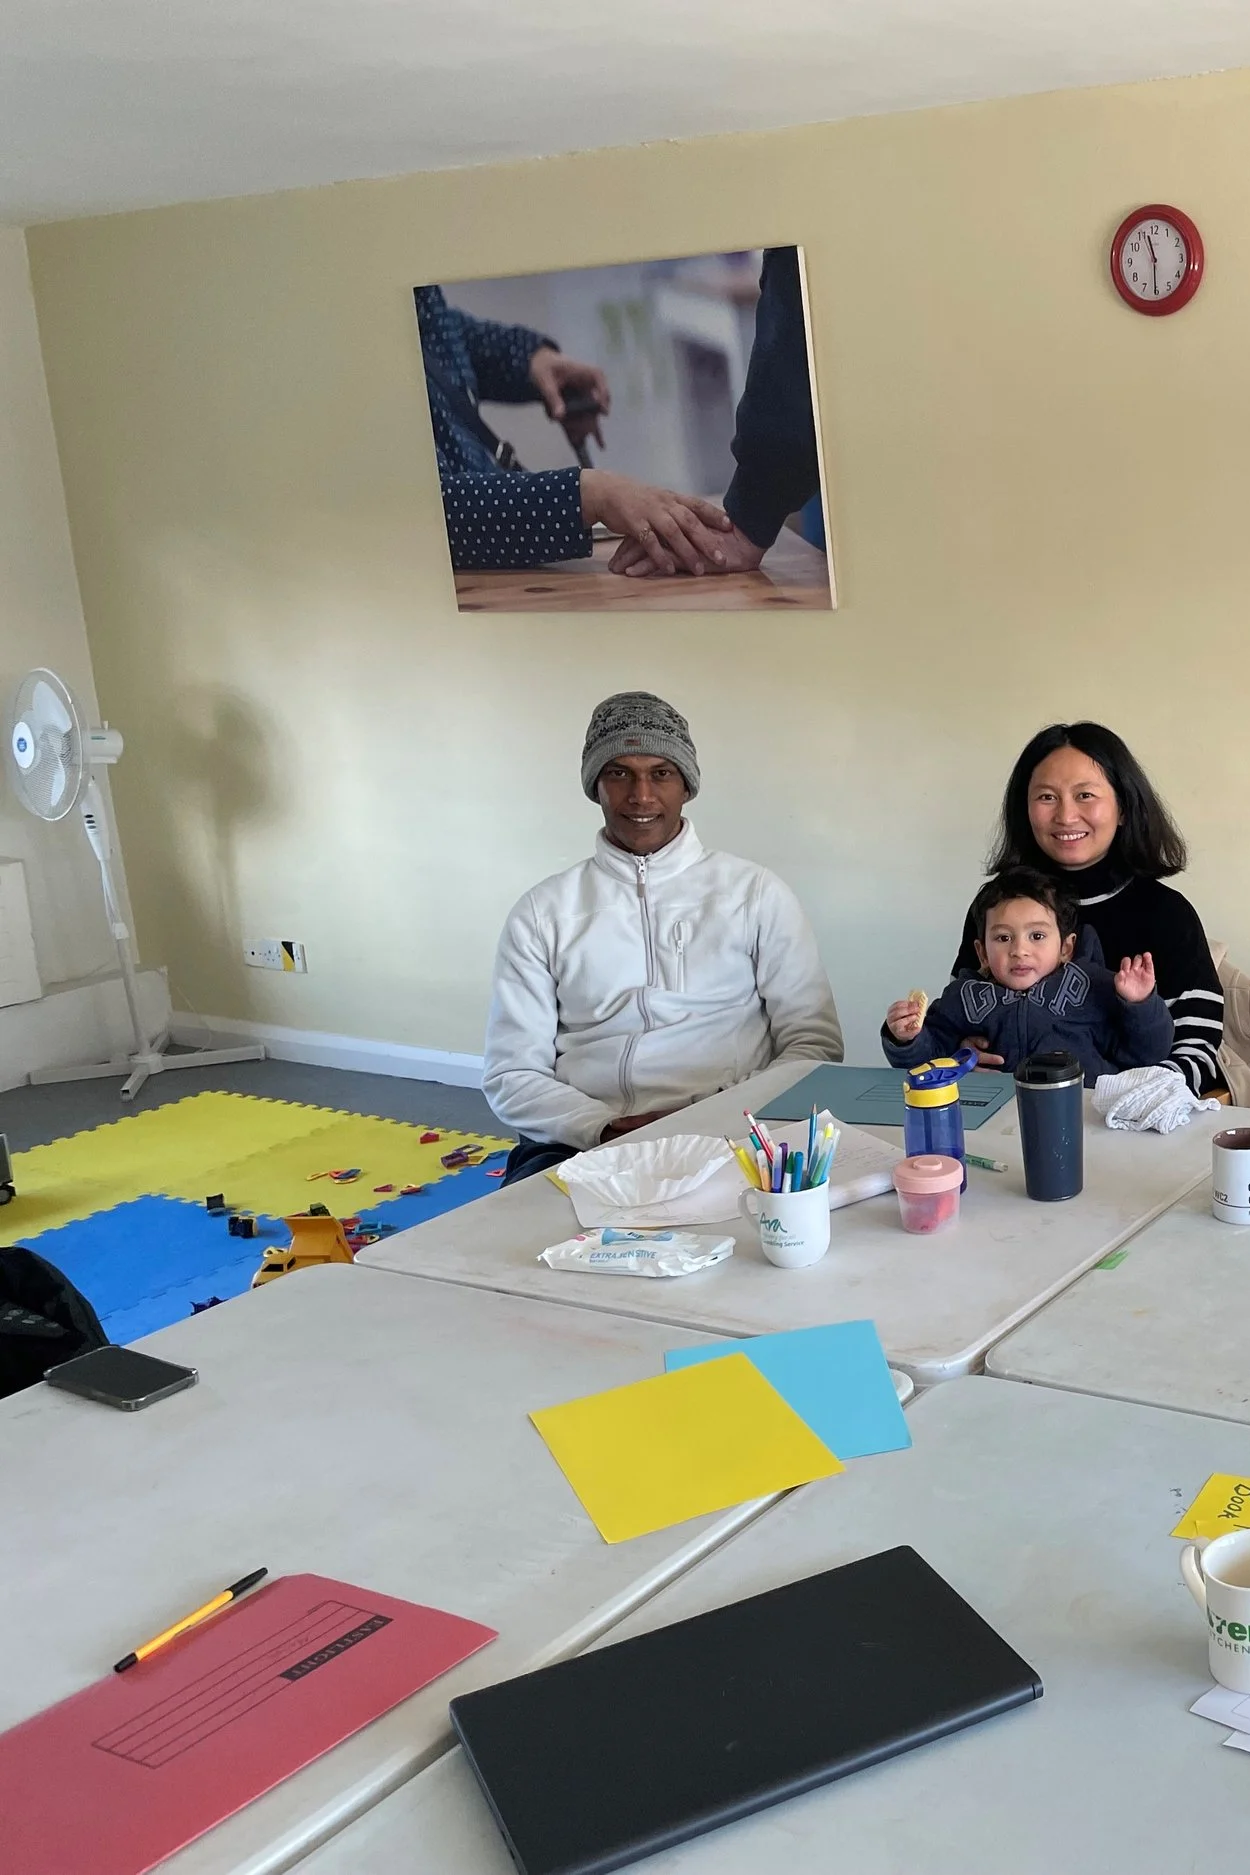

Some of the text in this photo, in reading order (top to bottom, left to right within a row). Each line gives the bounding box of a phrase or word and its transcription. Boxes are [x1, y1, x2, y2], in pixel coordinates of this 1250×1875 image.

[1150, 226, 1159, 235] 12
[1166, 229, 1169, 237] 1
[1138, 231, 1146, 241] 11
[1174, 238, 1180, 247] 2
[1131, 243, 1140, 252] 10
[1128, 259, 1133, 267] 9
[1179, 254, 1183, 263] 3
[1133, 273, 1138, 282] 8
[1175, 270, 1180, 279] 4
[1142, 283, 1147, 292] 7
[1155, 286, 1159, 295] 6
[1167, 282, 1171, 291] 5
[618, 1249, 657, 1259] SENSTIVE
[291, 1618, 386, 1677] EASTLIGHT
